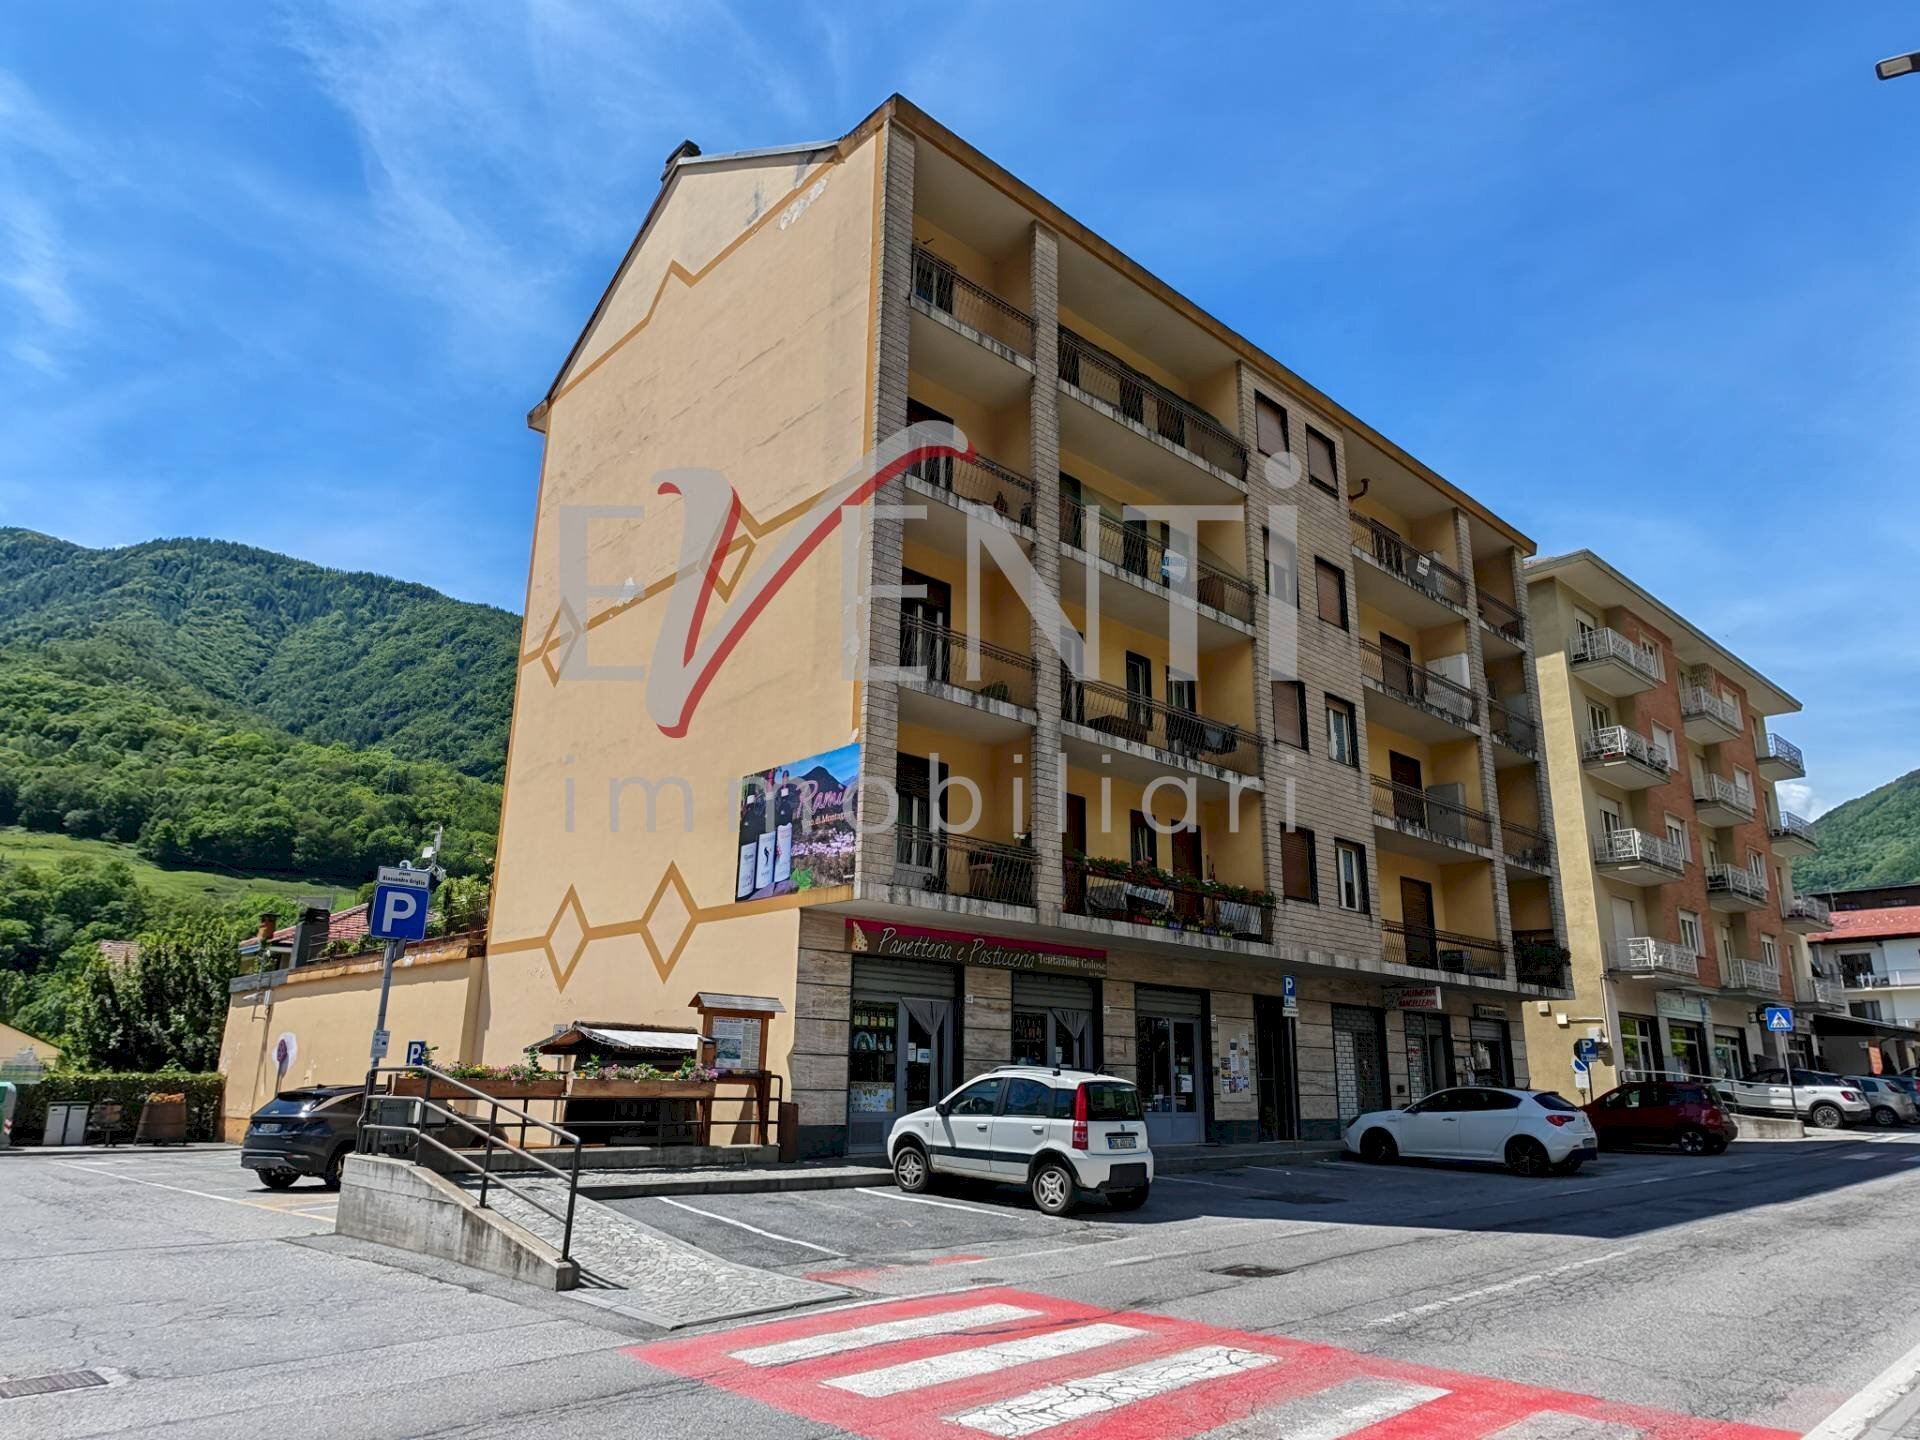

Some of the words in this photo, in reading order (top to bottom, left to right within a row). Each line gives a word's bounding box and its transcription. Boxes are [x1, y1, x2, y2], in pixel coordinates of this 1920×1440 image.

[381, 890, 417, 933] P
[878, 927, 951, 961] Panetteria
[956, 946, 964, 961] e
[968, 937, 1036, 969] Pasticceria
[1038, 952, 1080, 969] Tentazioni
[1081, 957, 1106, 970] Golose
[1285, 976, 1294, 994] P
[409, 1043, 422, 1066] P
[1581, 1039, 1593, 1053] P
